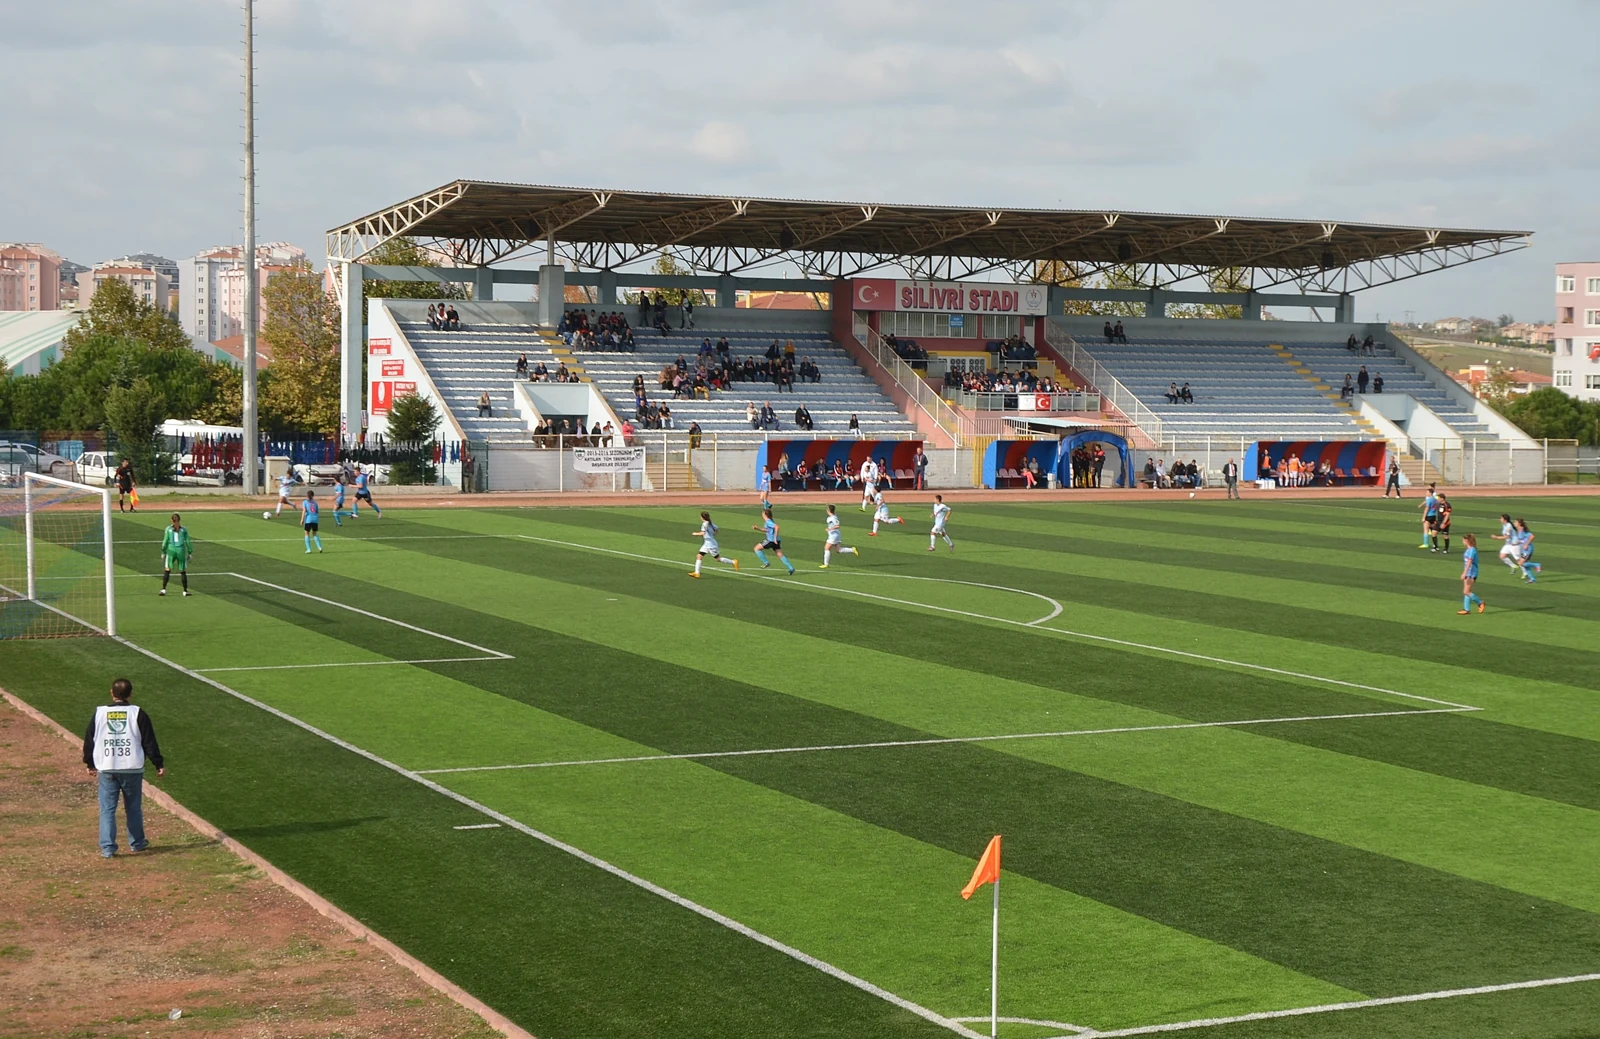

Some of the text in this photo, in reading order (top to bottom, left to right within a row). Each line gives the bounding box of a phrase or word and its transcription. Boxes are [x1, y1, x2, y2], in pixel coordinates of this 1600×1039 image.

[901, 281, 1019, 312] SİLİVRİ STADI
[104, 738, 131, 747] PRESS
[104, 747, 131, 757] 0138
